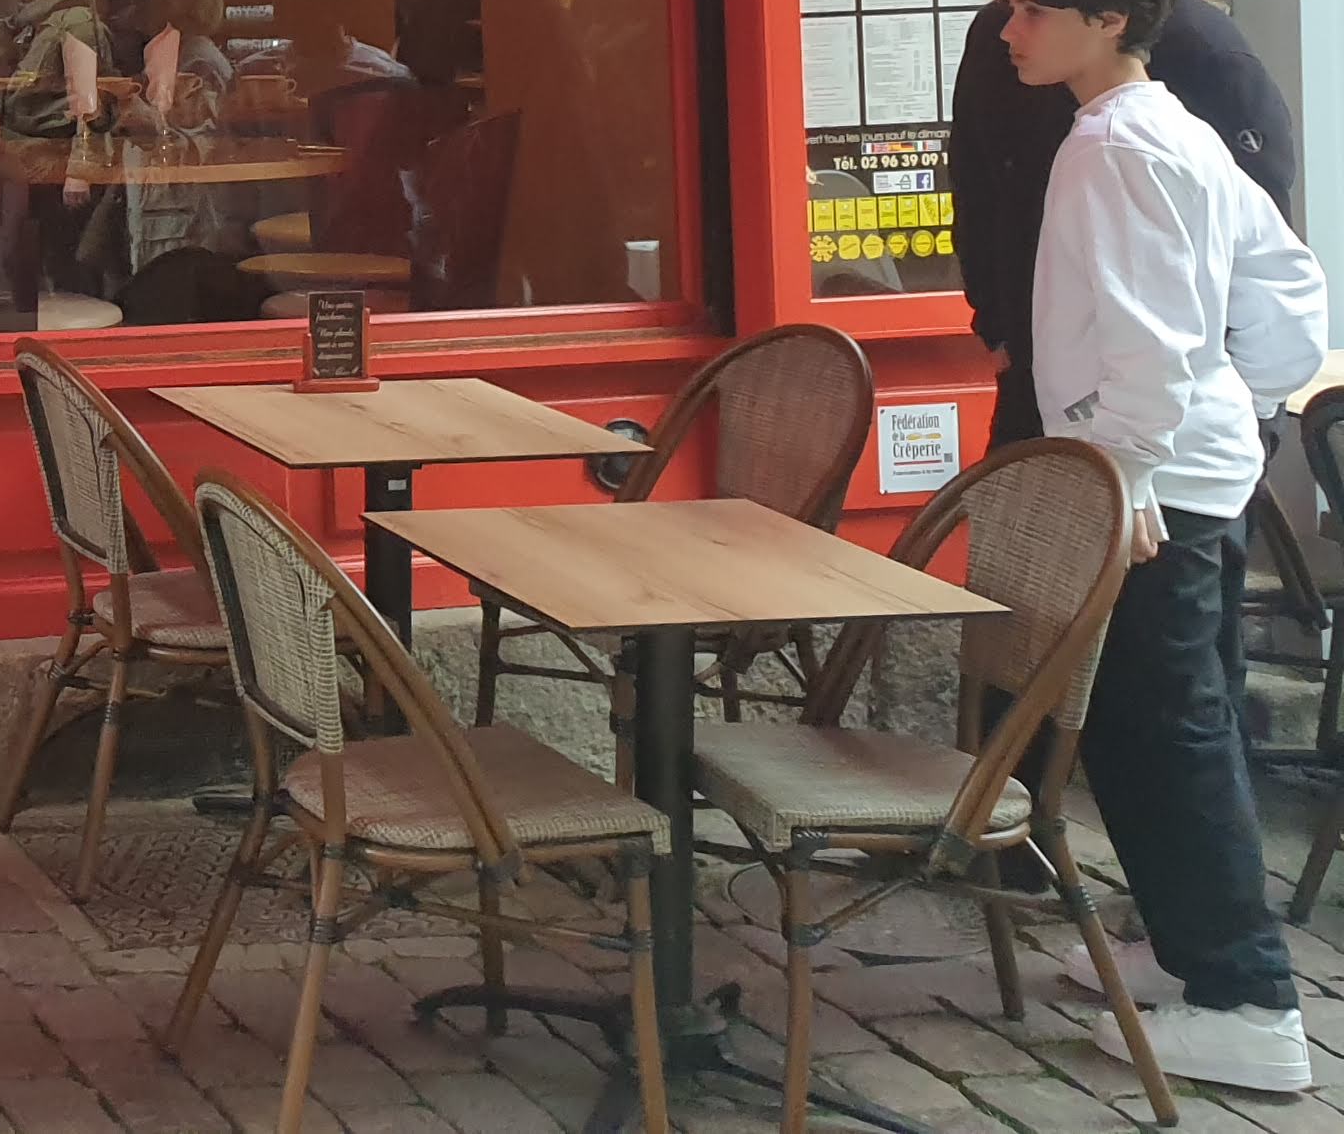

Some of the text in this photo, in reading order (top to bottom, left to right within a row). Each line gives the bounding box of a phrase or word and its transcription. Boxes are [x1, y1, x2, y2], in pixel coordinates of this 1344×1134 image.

[917, 128, 951, 139] diman
[833, 152, 949, 170] Tél. 02 96 39 09 1
[892, 413, 940, 431] Fédération
[893, 440, 941, 460] Crêperie
